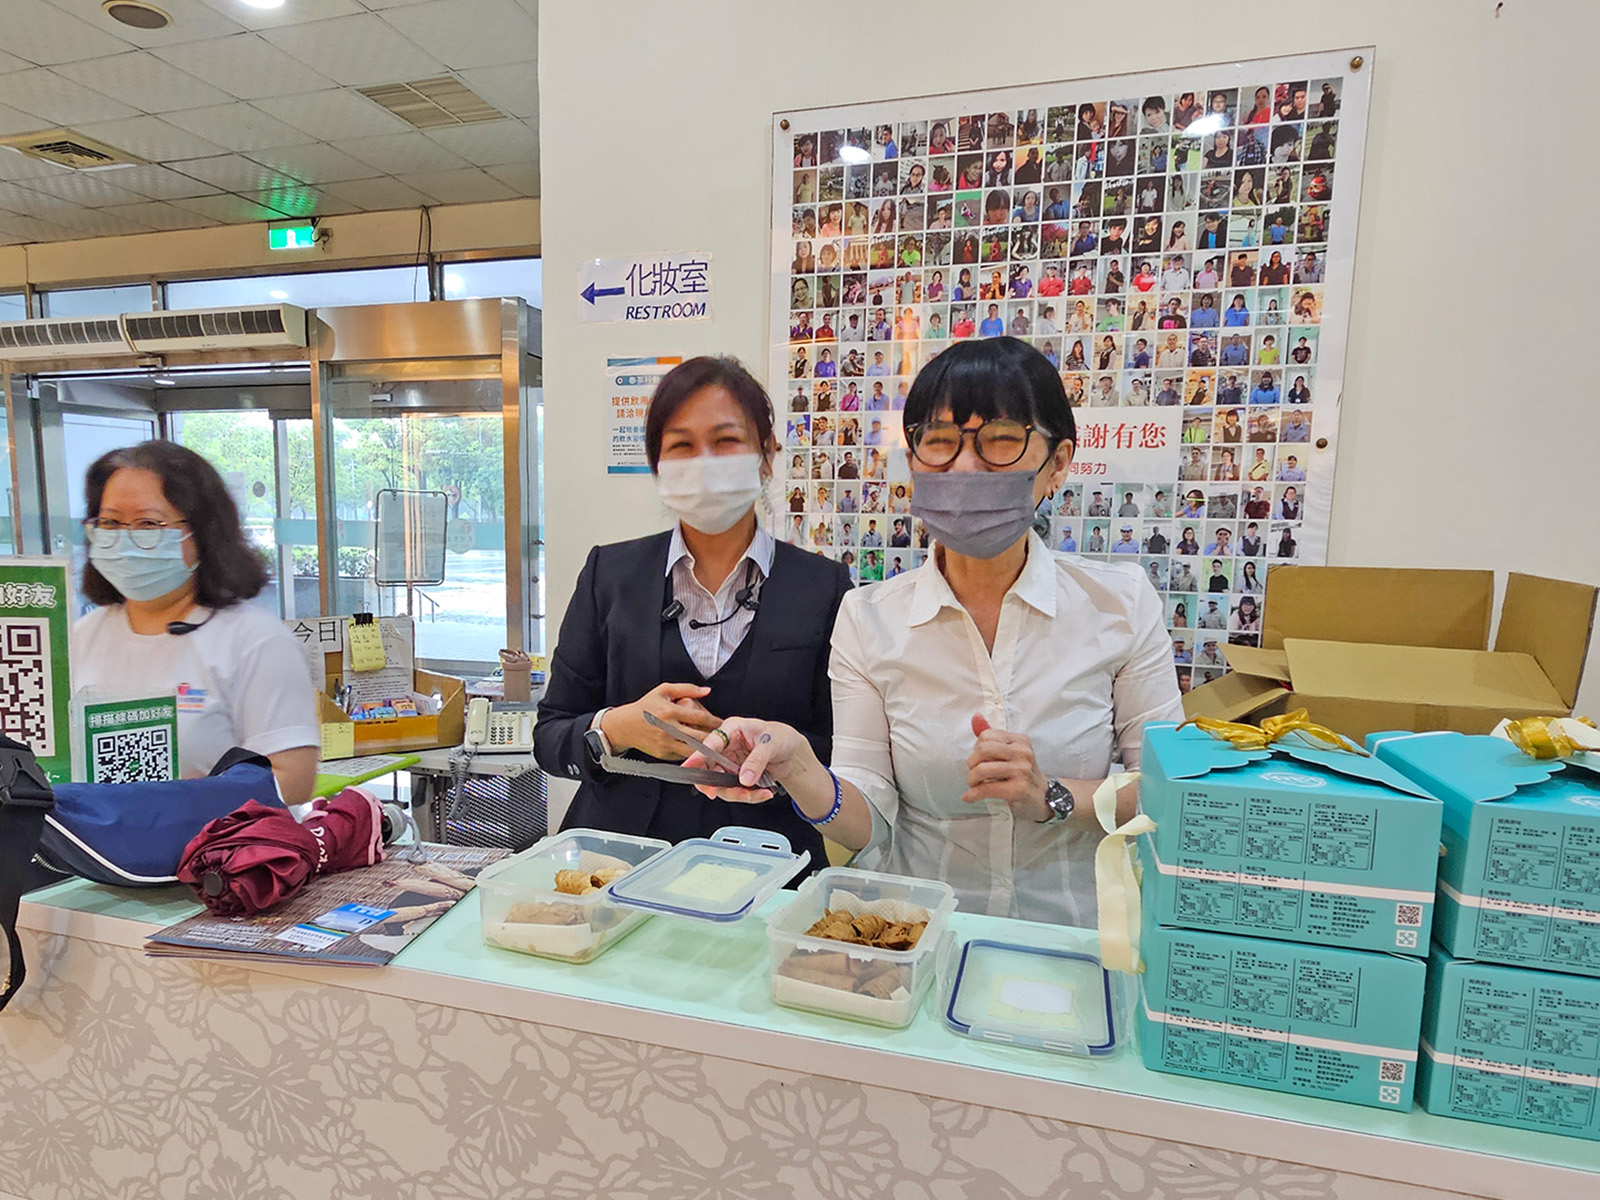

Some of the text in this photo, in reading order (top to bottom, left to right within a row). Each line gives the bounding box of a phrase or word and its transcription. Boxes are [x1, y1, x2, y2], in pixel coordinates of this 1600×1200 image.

[625, 259, 709, 297] 化妝室
[625, 302, 706, 320] RESTROOM
[616, 408, 648, 419] 請洽現
[293, 620, 336, 644] 今日
